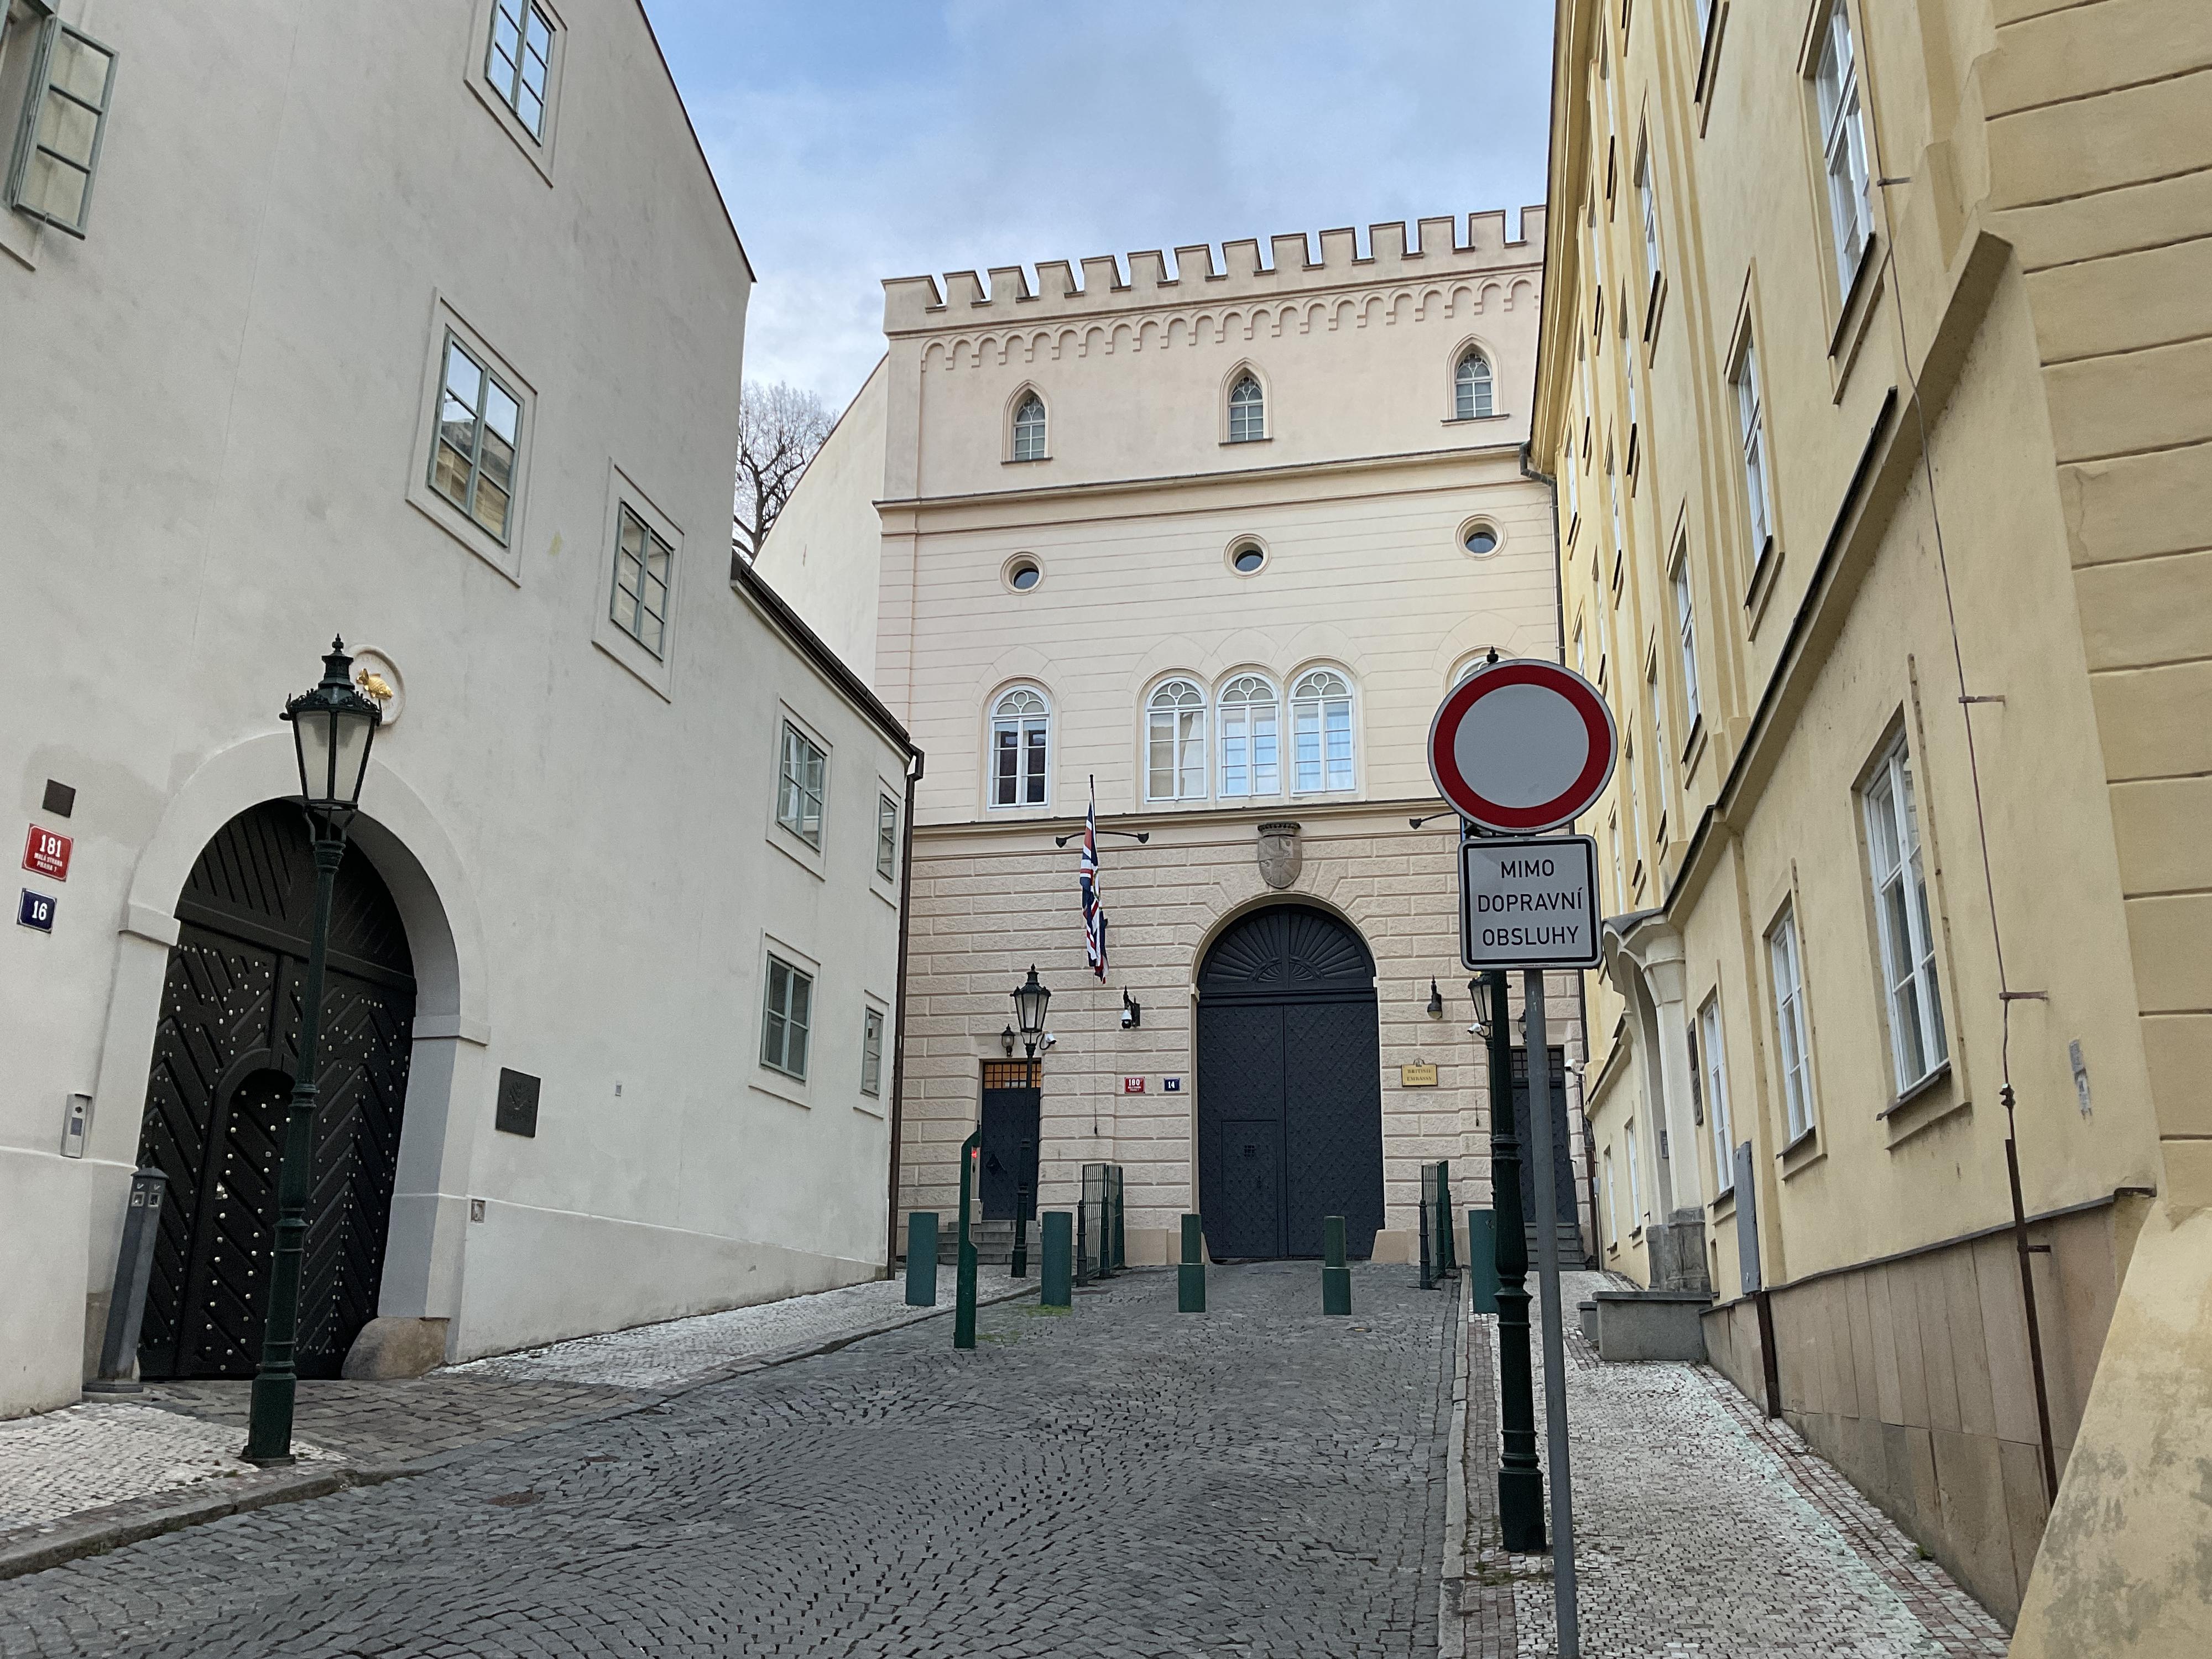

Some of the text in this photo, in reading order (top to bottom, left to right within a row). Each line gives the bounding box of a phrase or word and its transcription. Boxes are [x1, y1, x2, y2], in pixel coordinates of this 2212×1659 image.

[40, 834, 61, 858] 181
[1501, 859, 1554, 878] MIMO
[1478, 887, 1583, 912] DOPRAVNÍ
[32, 900, 48, 921] 16
[1482, 926, 1579, 946] OBSLUHY
